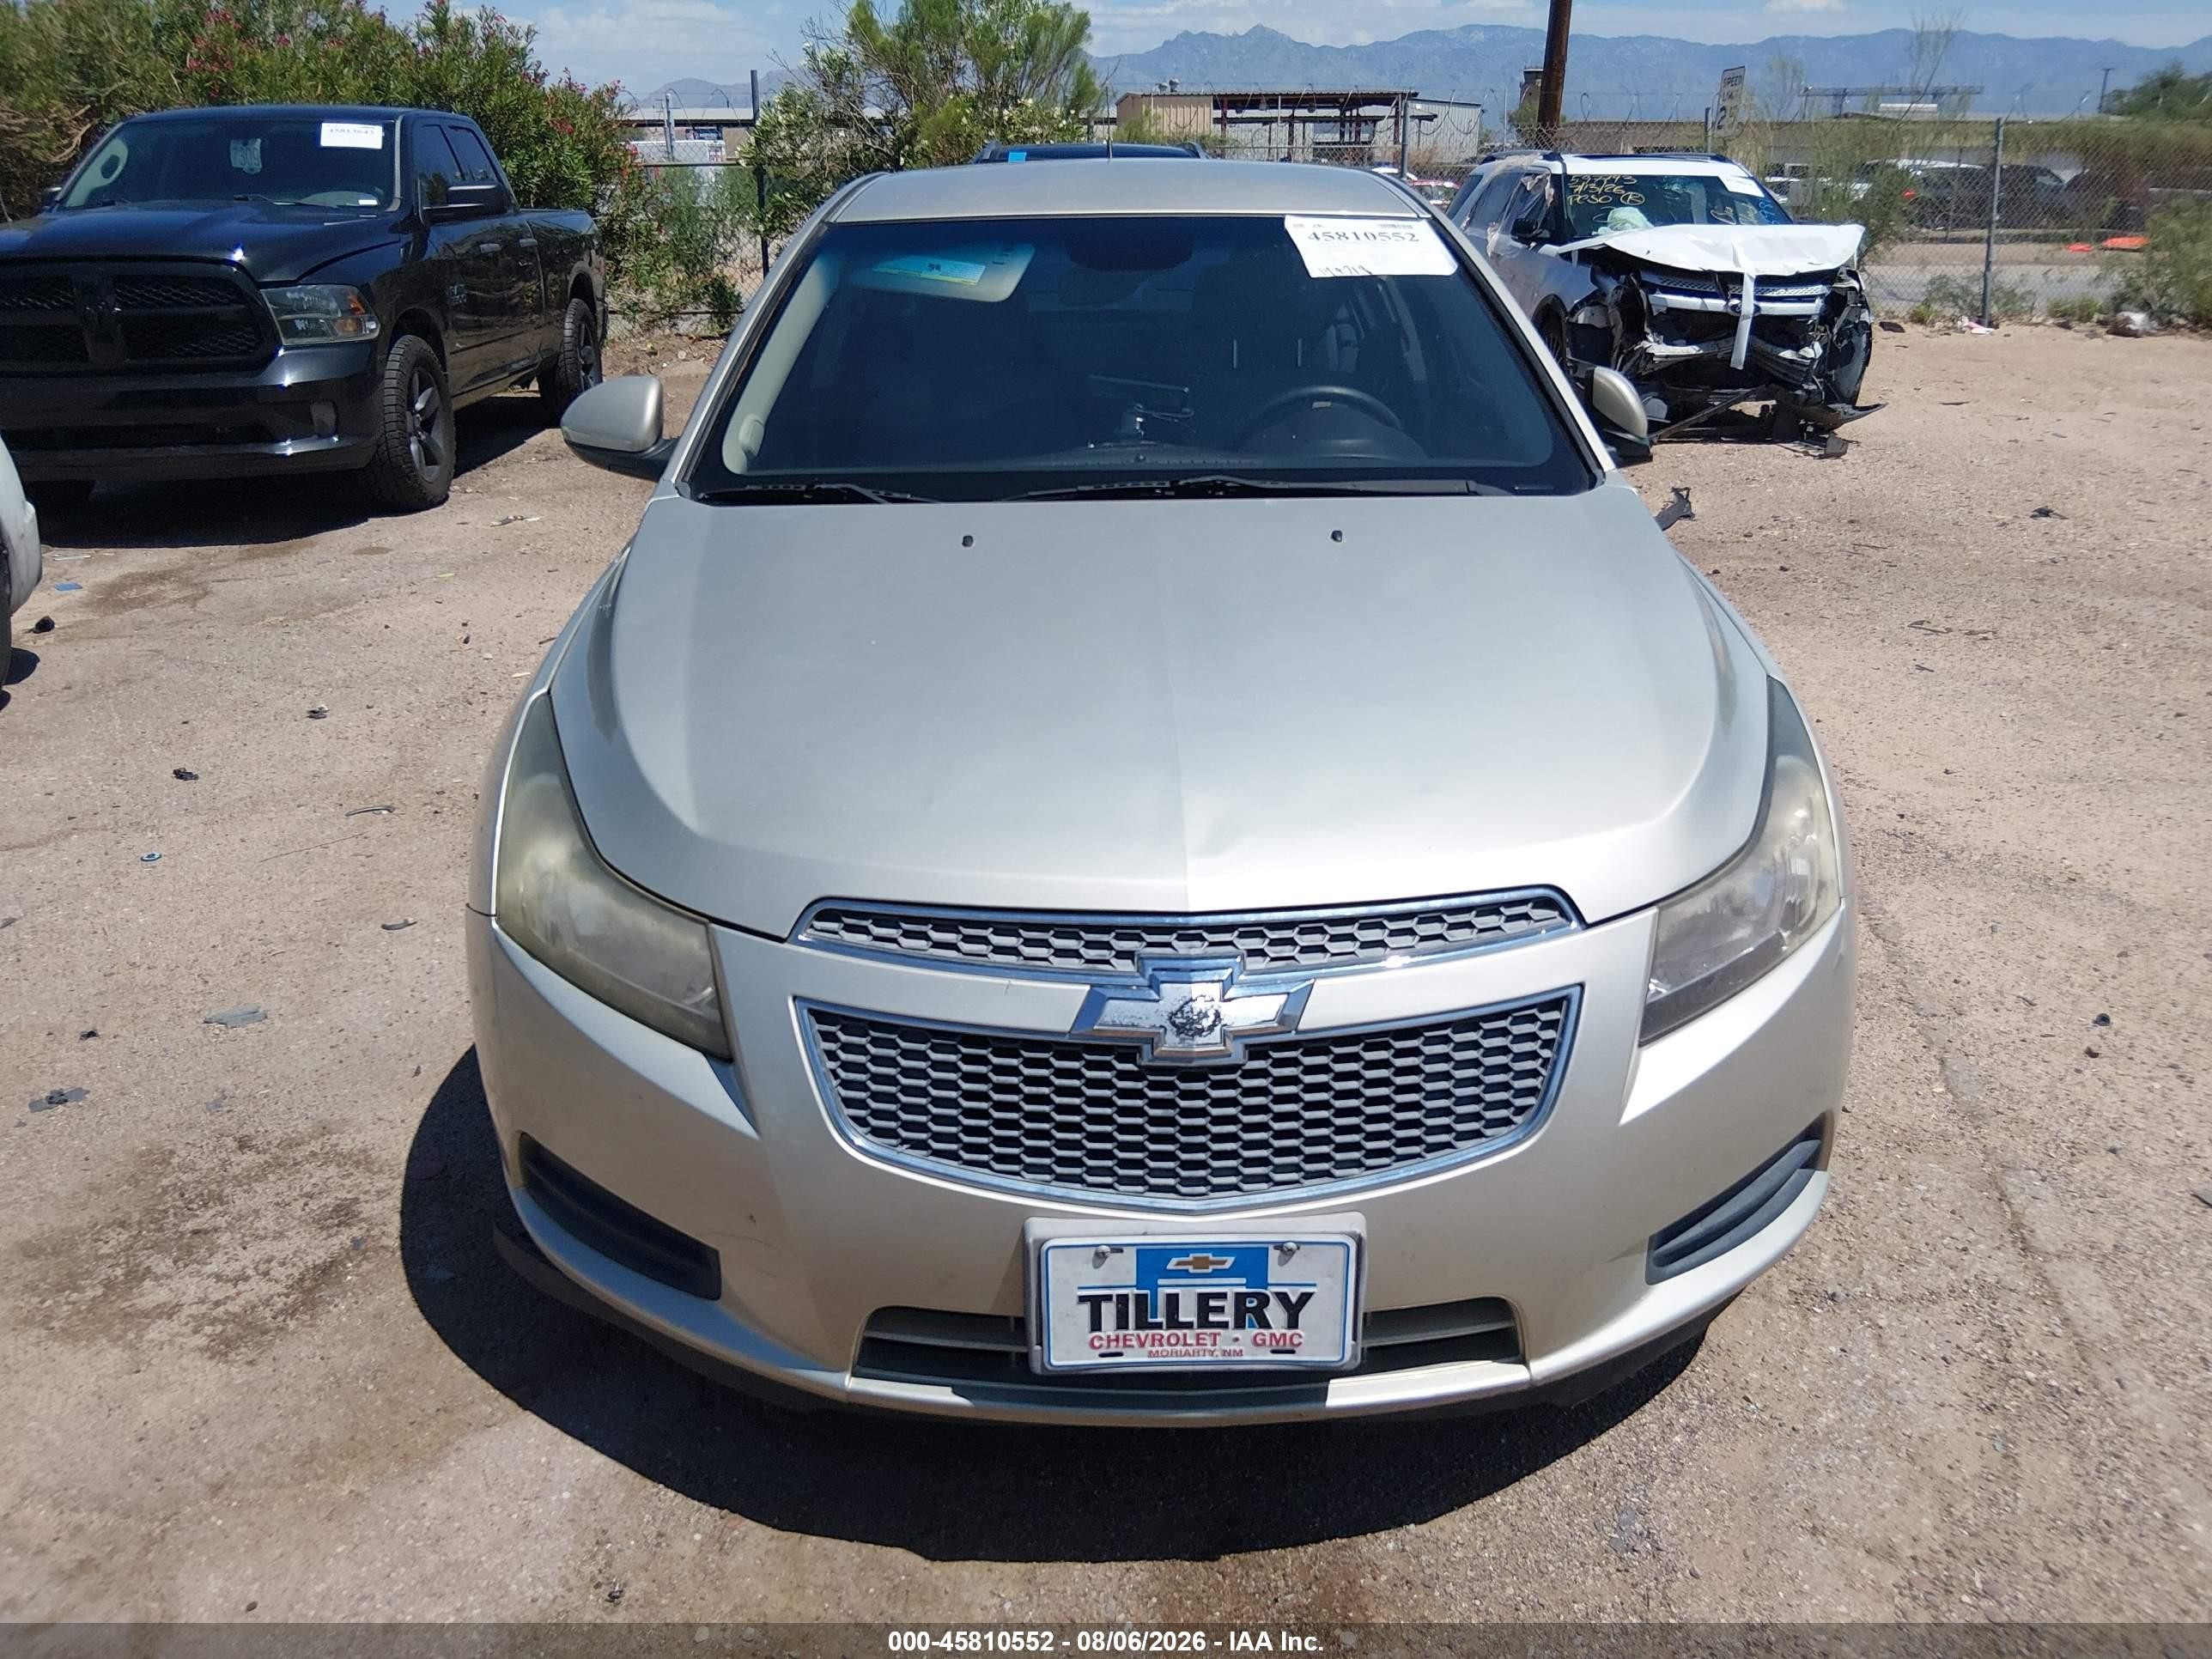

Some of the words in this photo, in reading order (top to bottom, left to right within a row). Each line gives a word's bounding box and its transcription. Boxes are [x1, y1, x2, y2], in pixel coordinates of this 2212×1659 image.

[1307, 231, 1419, 242] 45810552
[1077, 1290, 1316, 1333] TILLERY
[1088, 1332, 1222, 1350] CHEVROLET
[1252, 1331, 1304, 1348] GMC
[1147, 1347, 1219, 1358] MORIARTY,
[1222, 1348, 1244, 1358] NM
